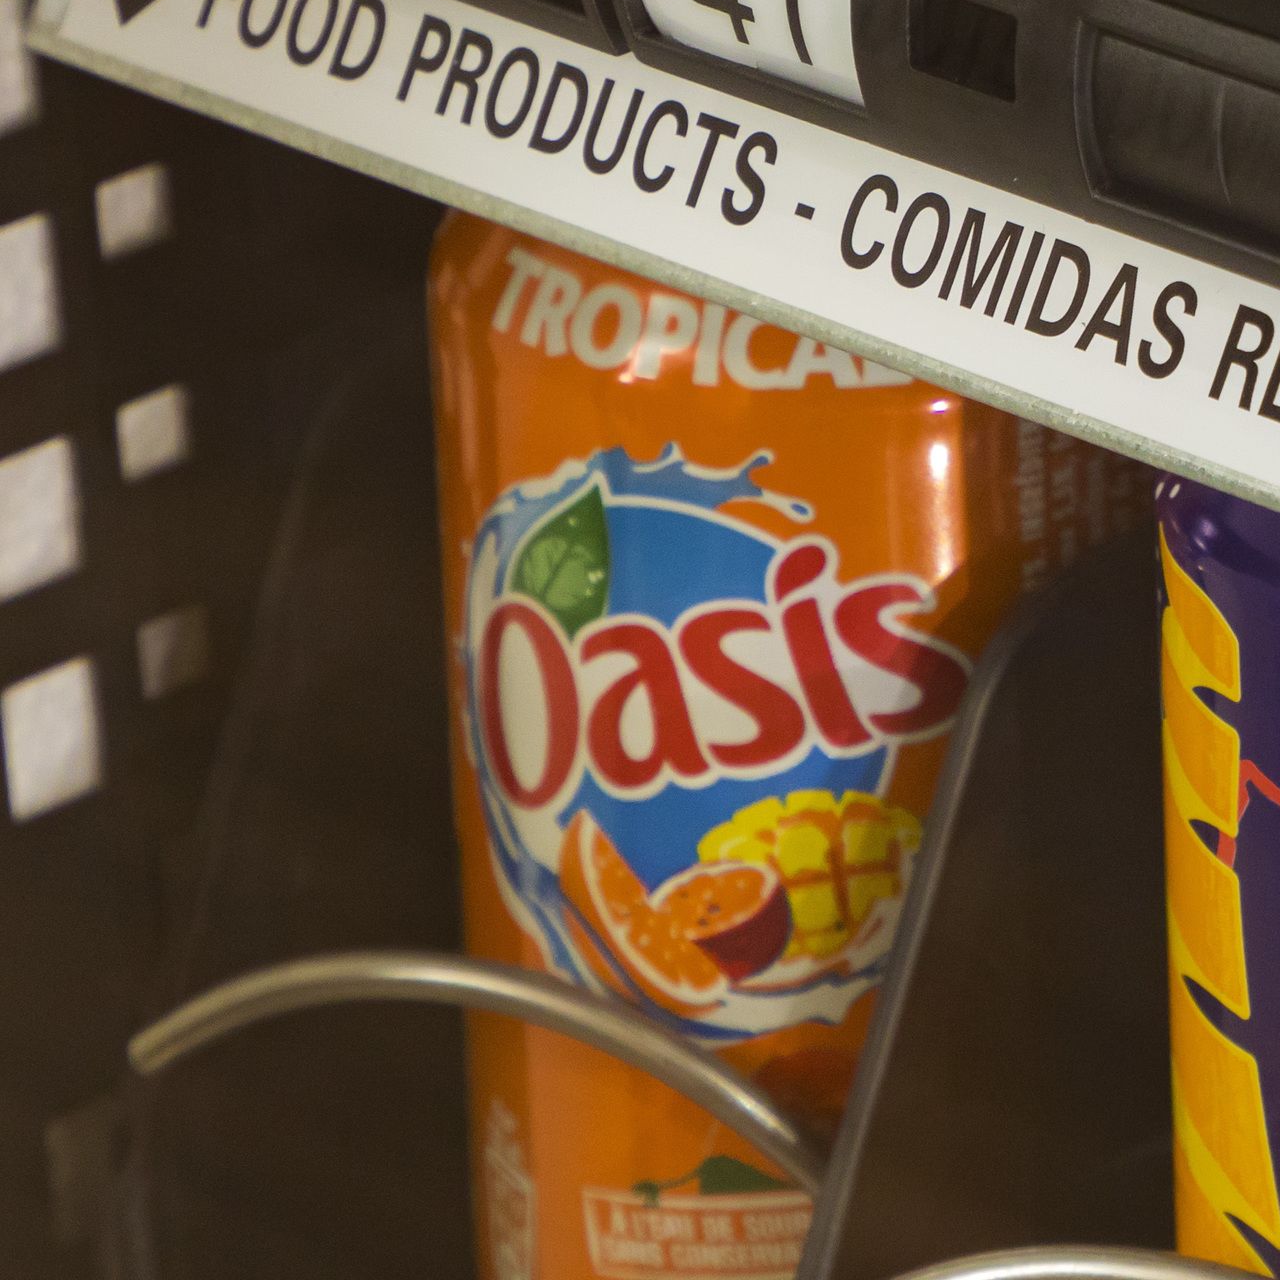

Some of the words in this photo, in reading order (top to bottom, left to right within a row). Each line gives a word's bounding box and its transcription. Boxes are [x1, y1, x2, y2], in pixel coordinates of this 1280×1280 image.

[395, 15, 778, 226] PRODUCTS
[839, 174, 1198, 380] COMIDAS
[480, 540, 972, 812] Oasis
